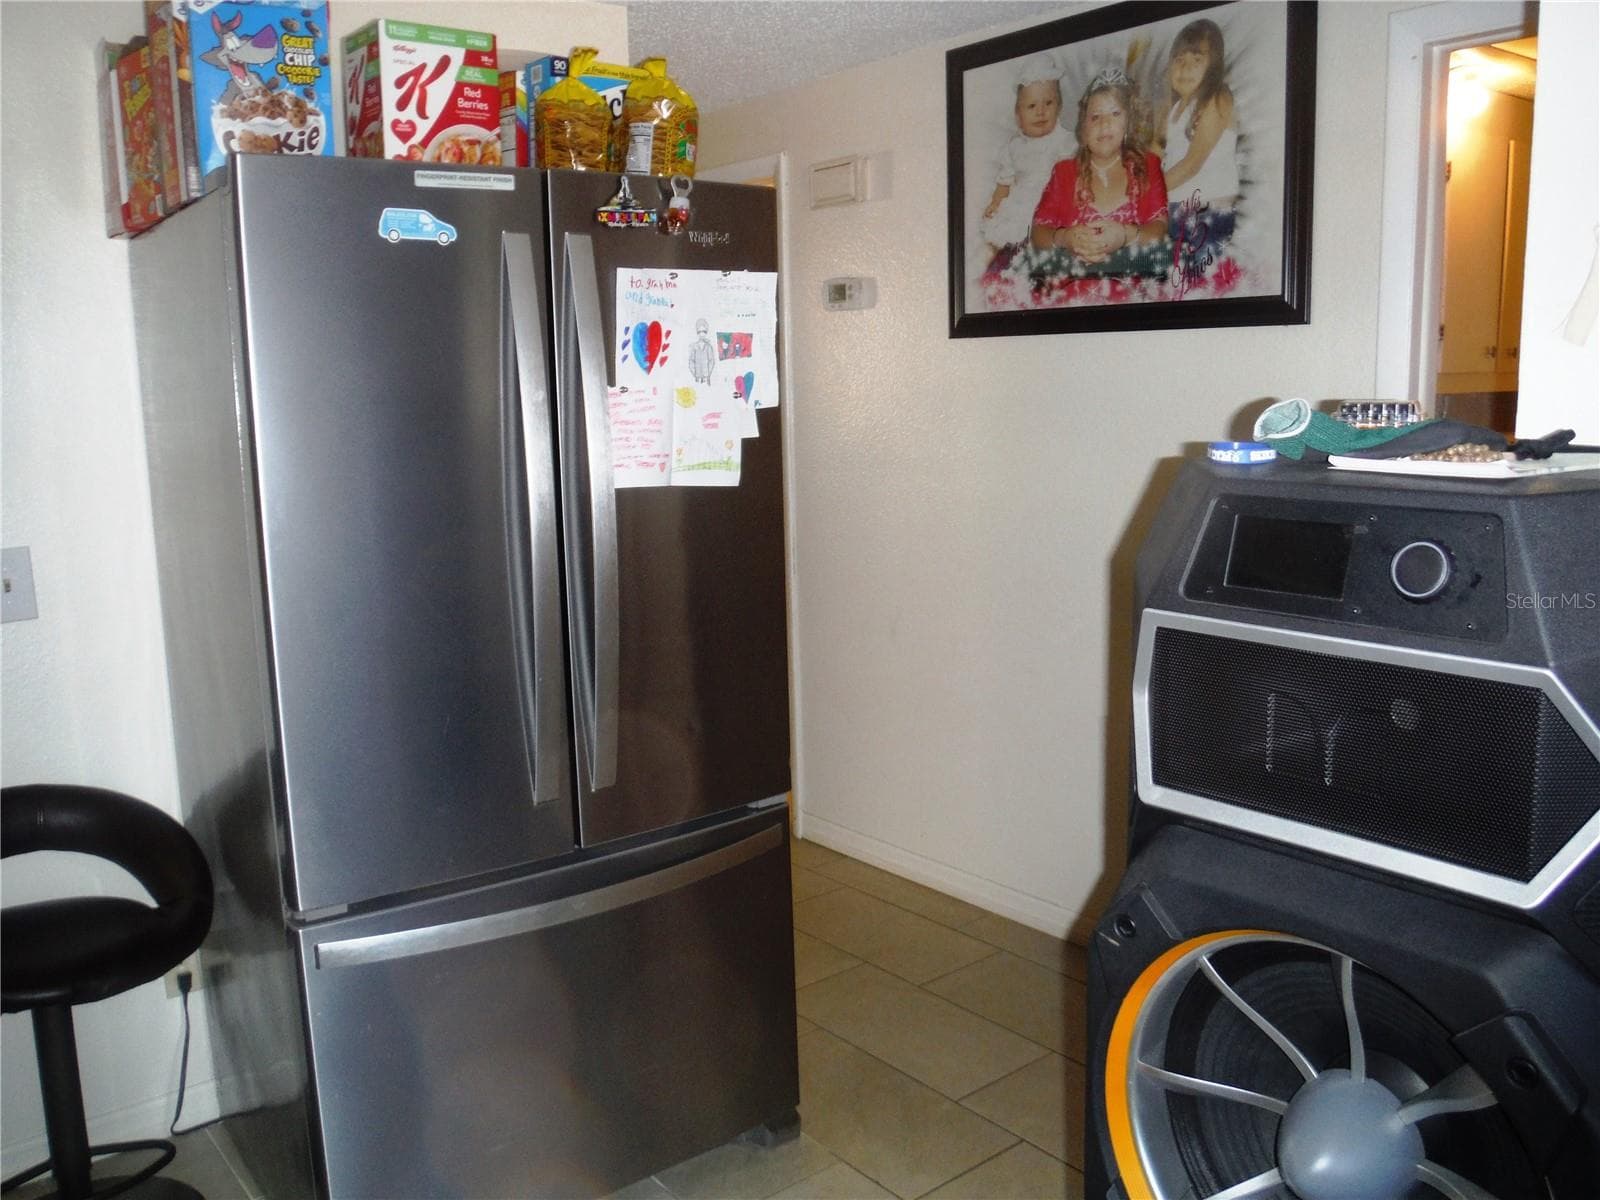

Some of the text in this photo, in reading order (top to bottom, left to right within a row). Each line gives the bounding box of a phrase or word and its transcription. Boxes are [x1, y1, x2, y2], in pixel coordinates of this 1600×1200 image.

[285, 52, 316, 66] CHIP
[553, 60, 566, 71] 90
[394, 54, 452, 120] K
[463, 86, 482, 98] Red
[457, 97, 489, 110] Berries
